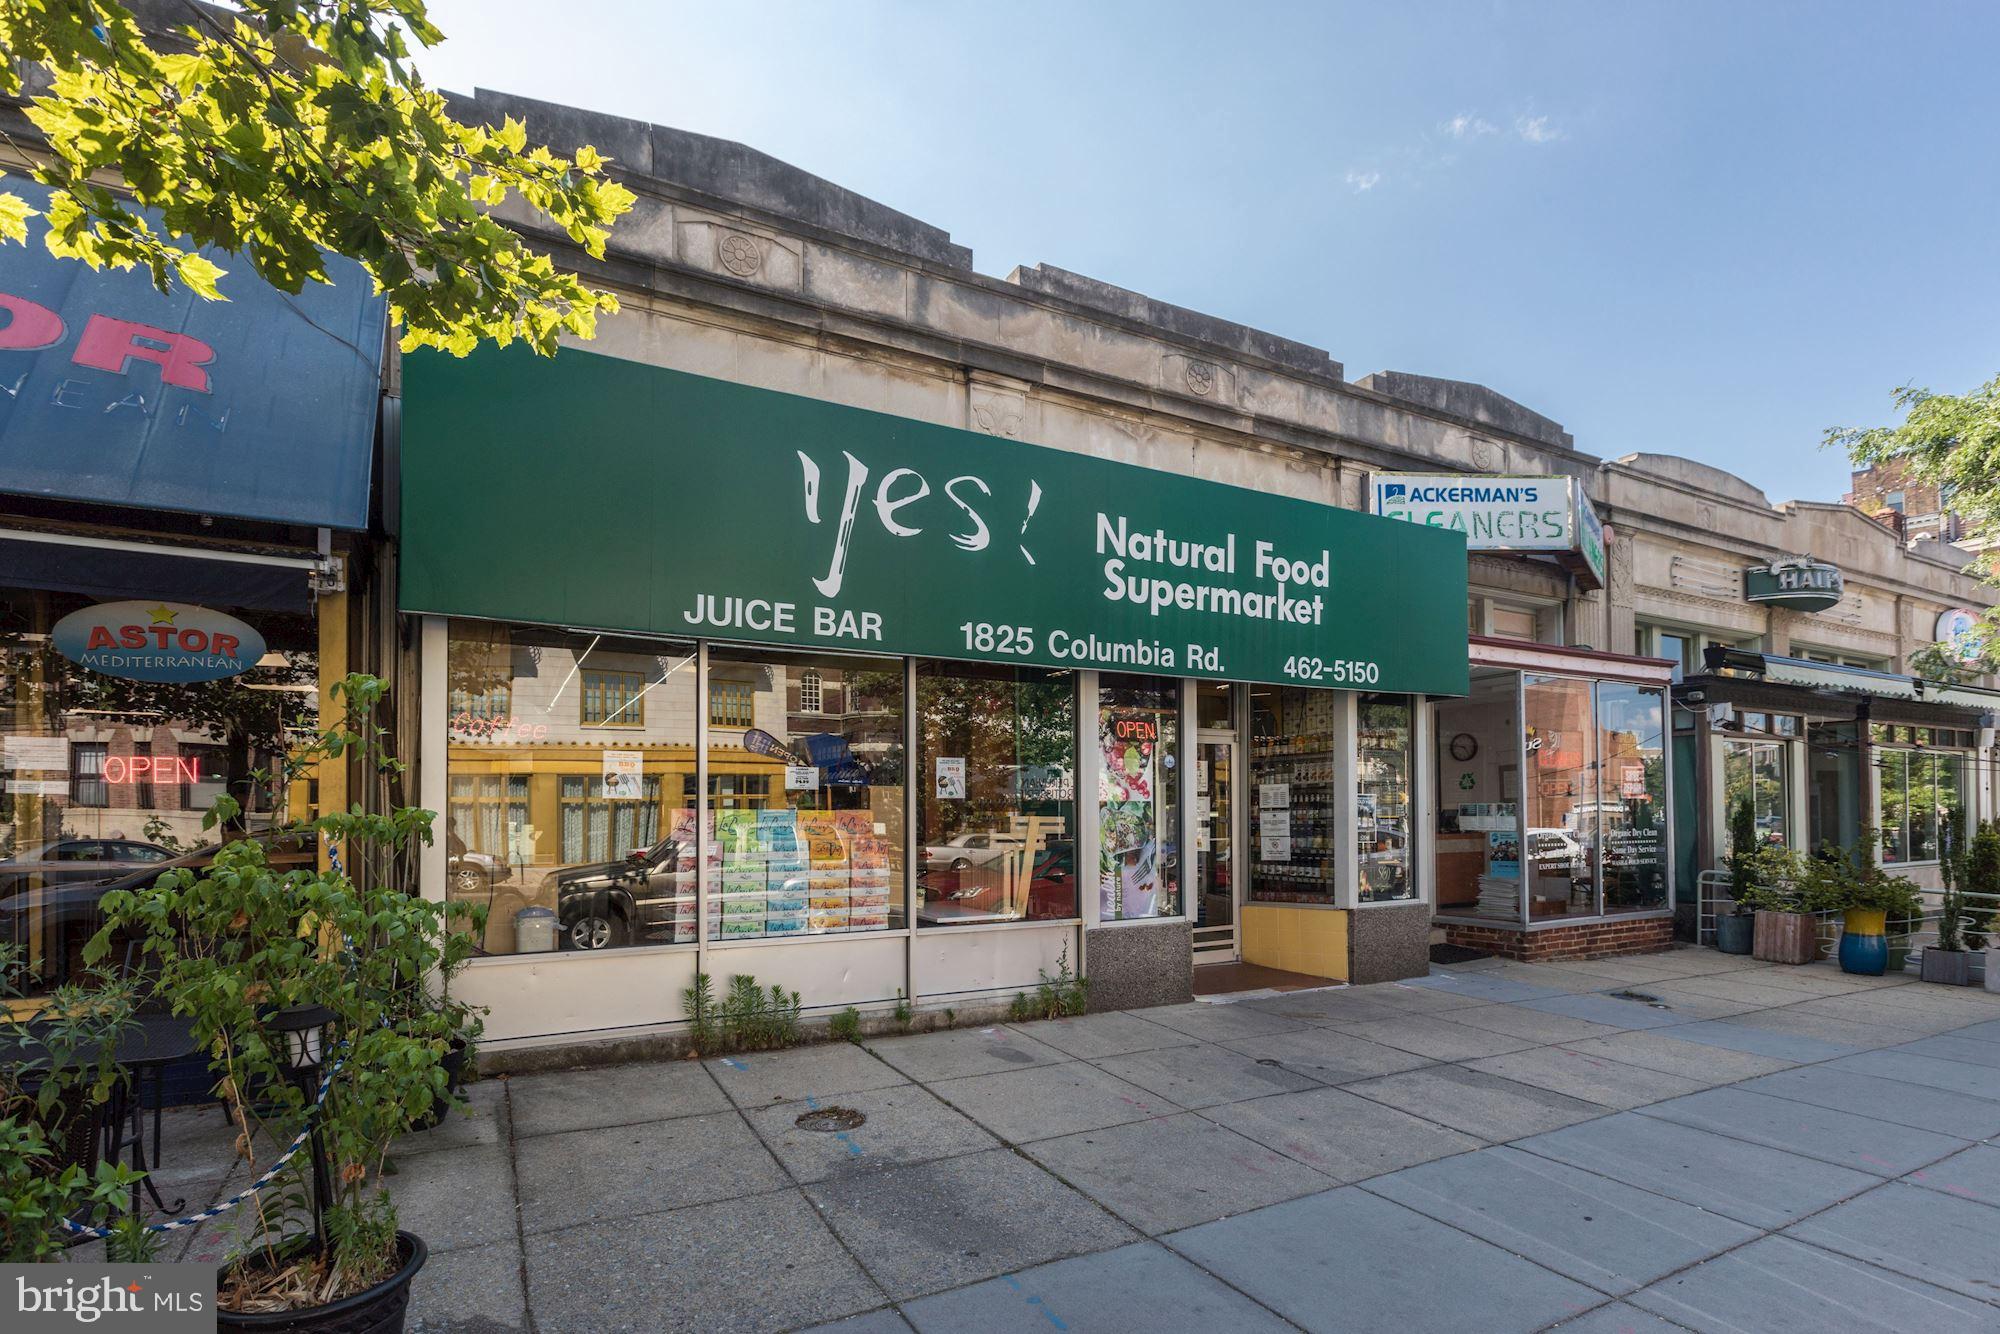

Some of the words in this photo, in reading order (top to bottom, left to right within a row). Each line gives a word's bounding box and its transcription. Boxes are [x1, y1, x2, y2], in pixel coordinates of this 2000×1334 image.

[1409, 487, 1538, 503] ACKERMAN'S
[1096, 512, 1235, 573] Natural
[1256, 540, 1330, 588] Food
[1103, 559, 1324, 625] Supermarket
[683, 594, 796, 633] JUICE
[814, 606, 882, 641] BAR
[87, 625, 240, 659] ASTOR
[959, 621, 1034, 655] 1825
[1048, 626, 1175, 668] Columbia
[1187, 643, 1225, 672] Rd.
[1284, 656, 1379, 684] 462-5150
[80, 653, 243, 671] MEDITERRANEAN
[453, 712, 548, 739] Coffee
[1117, 720, 1156, 740] OPEN
[104, 757, 199, 784] OPEN
[1643, 828, 1658, 836] Clean
[1115, 902, 1122, 912] by
